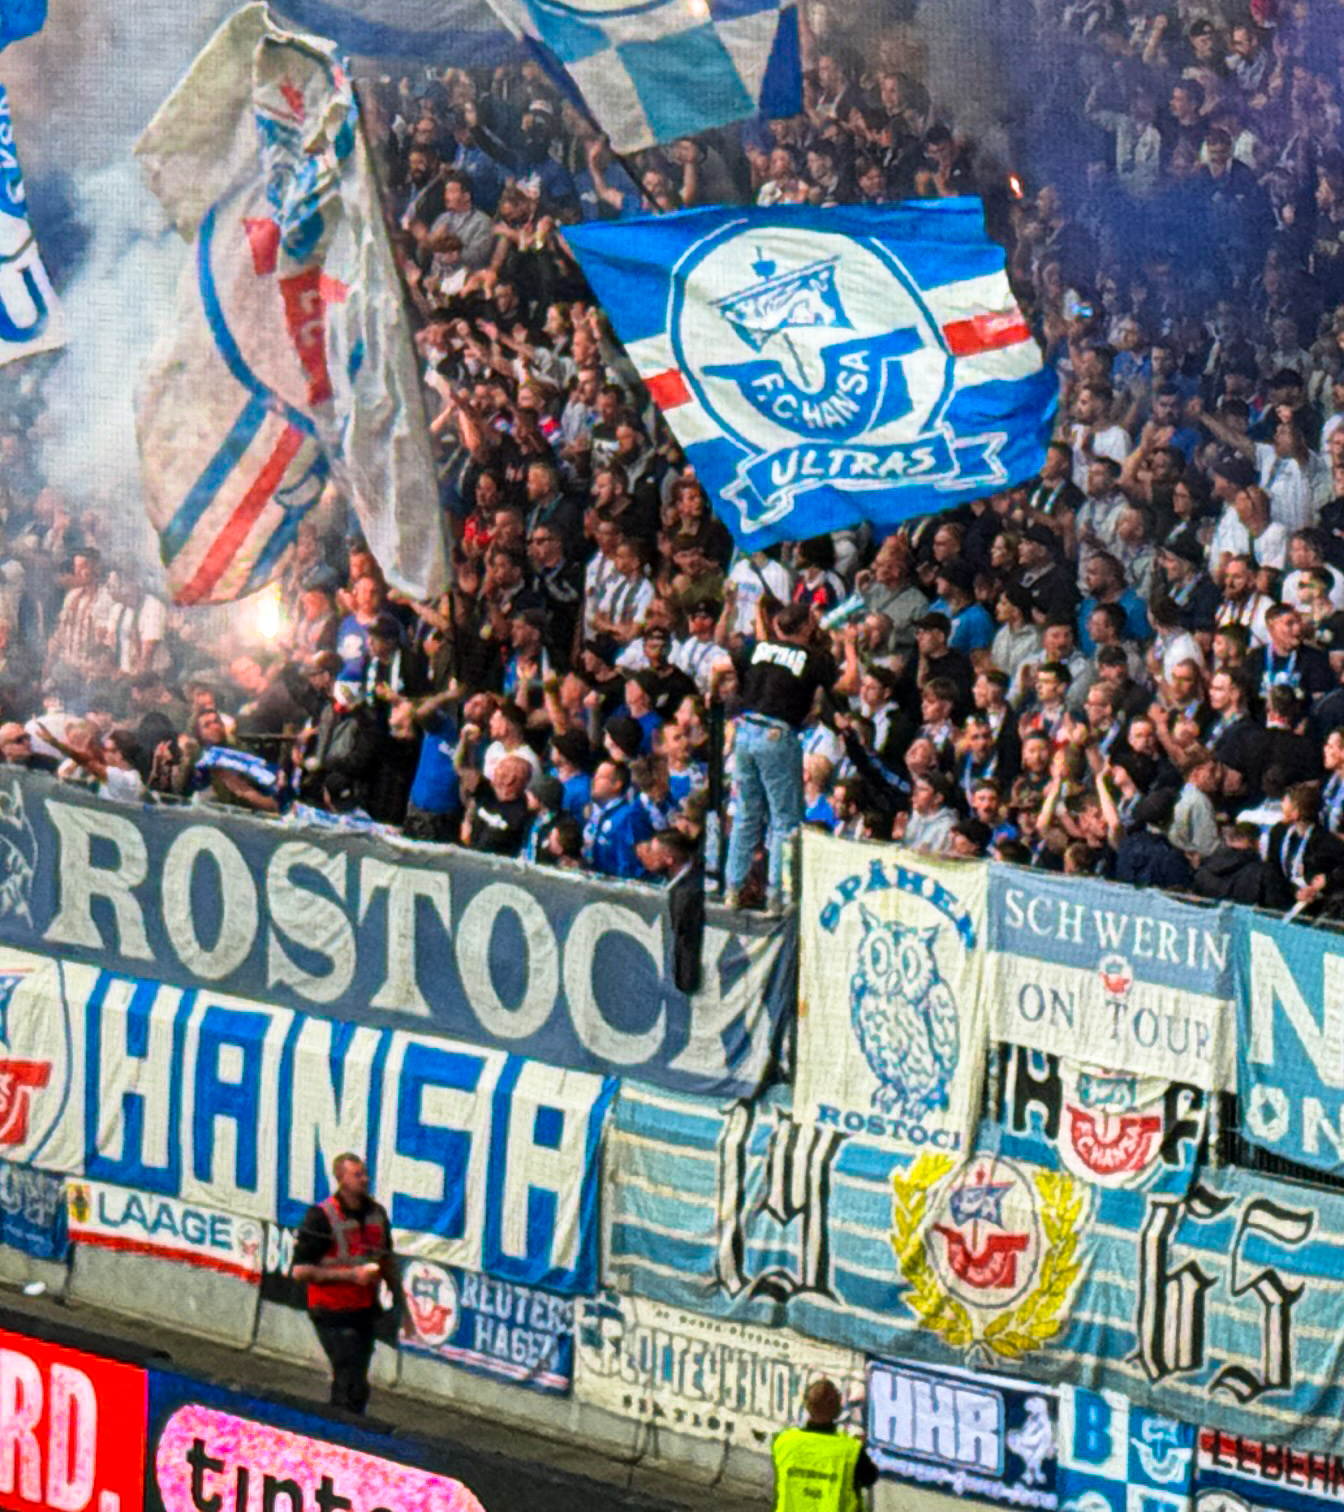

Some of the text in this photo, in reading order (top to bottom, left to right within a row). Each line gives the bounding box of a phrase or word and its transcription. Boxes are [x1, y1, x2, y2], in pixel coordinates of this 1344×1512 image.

[802, 350, 870, 430] HANSA
[771, 445, 938, 486] ULTRAS
[1005, 888, 1232, 971] SCHWERIN
[1018, 983, 1212, 1060] ON TOUR
[96, 974, 604, 1279] HANSA
[97, 1189, 235, 1252] LAAGE
